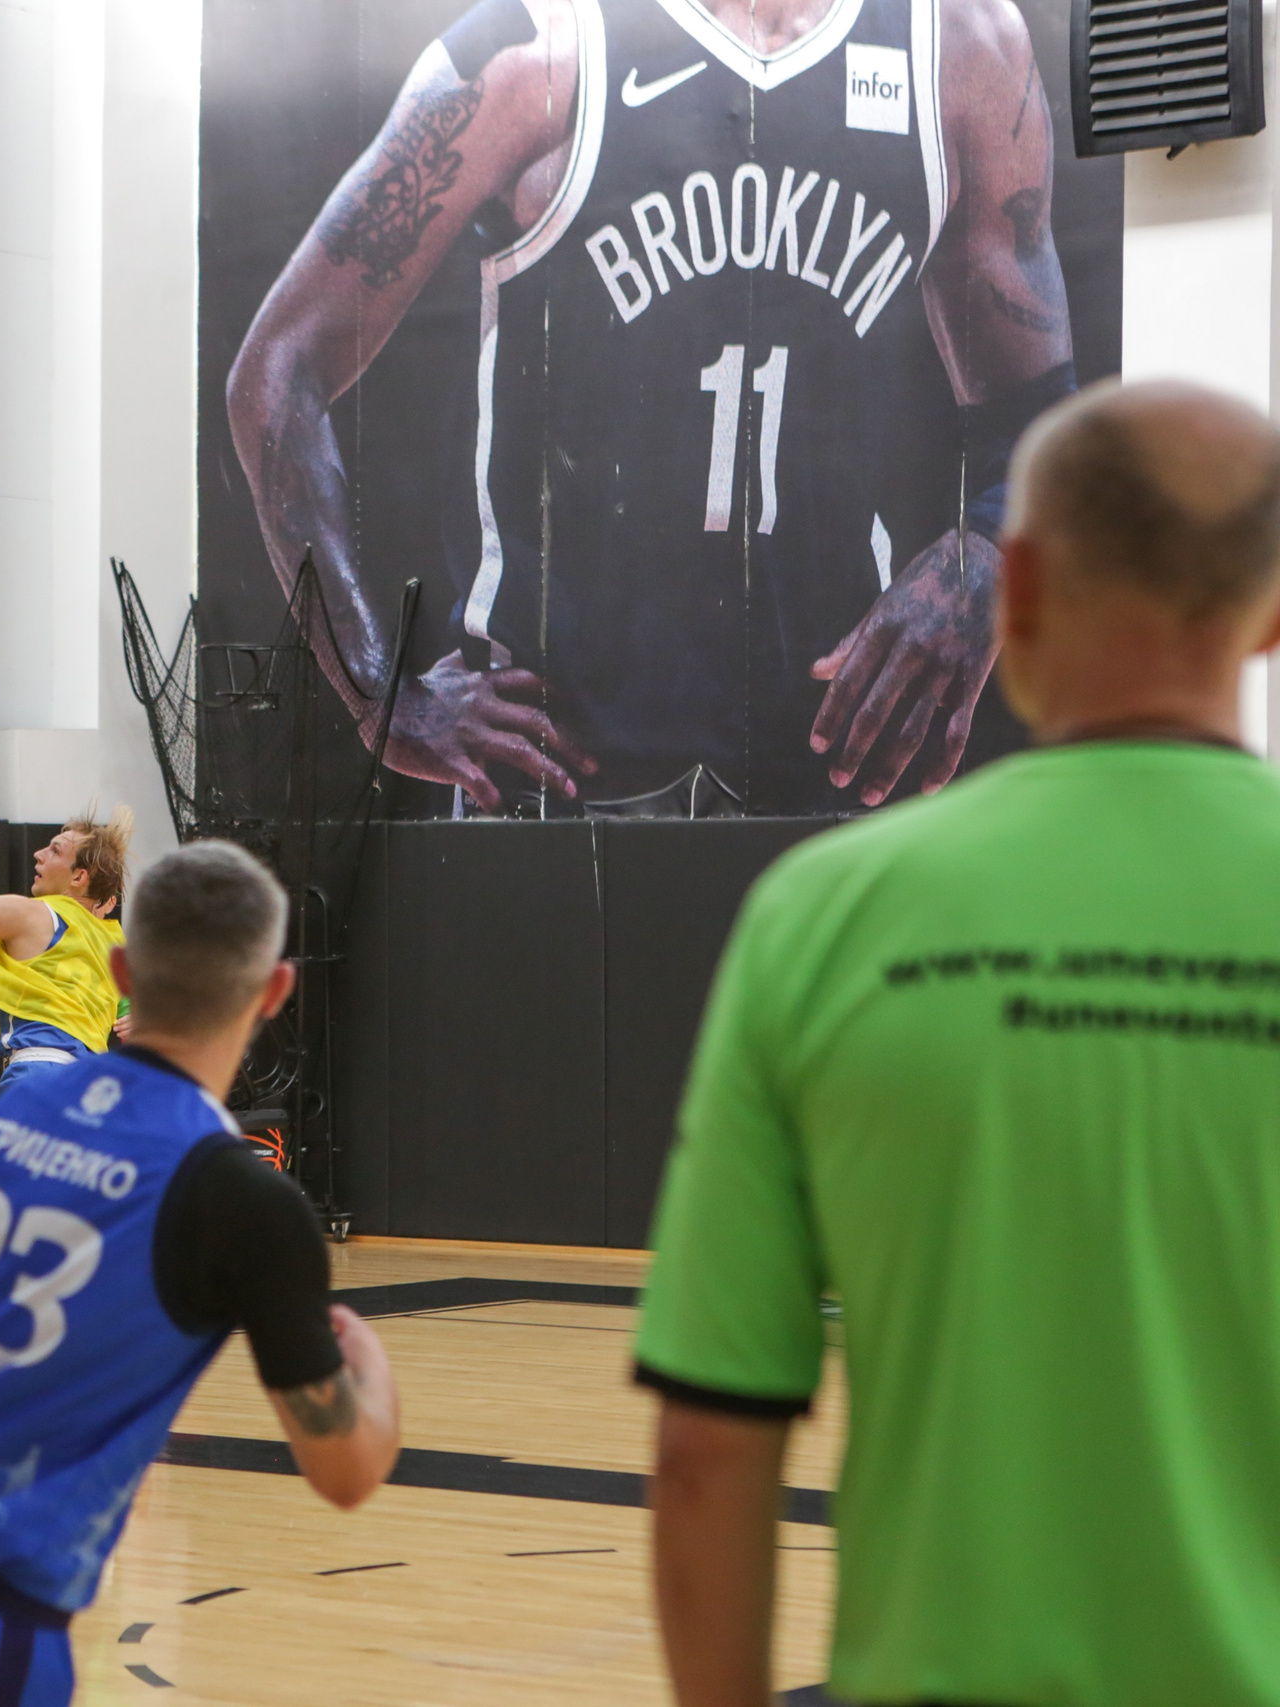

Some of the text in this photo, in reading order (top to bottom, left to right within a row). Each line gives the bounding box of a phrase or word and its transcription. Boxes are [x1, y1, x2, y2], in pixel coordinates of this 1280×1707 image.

[851, 70, 904, 101] infor
[584, 162, 913, 339] BROOKLYN
[700, 343, 789, 536] 11
